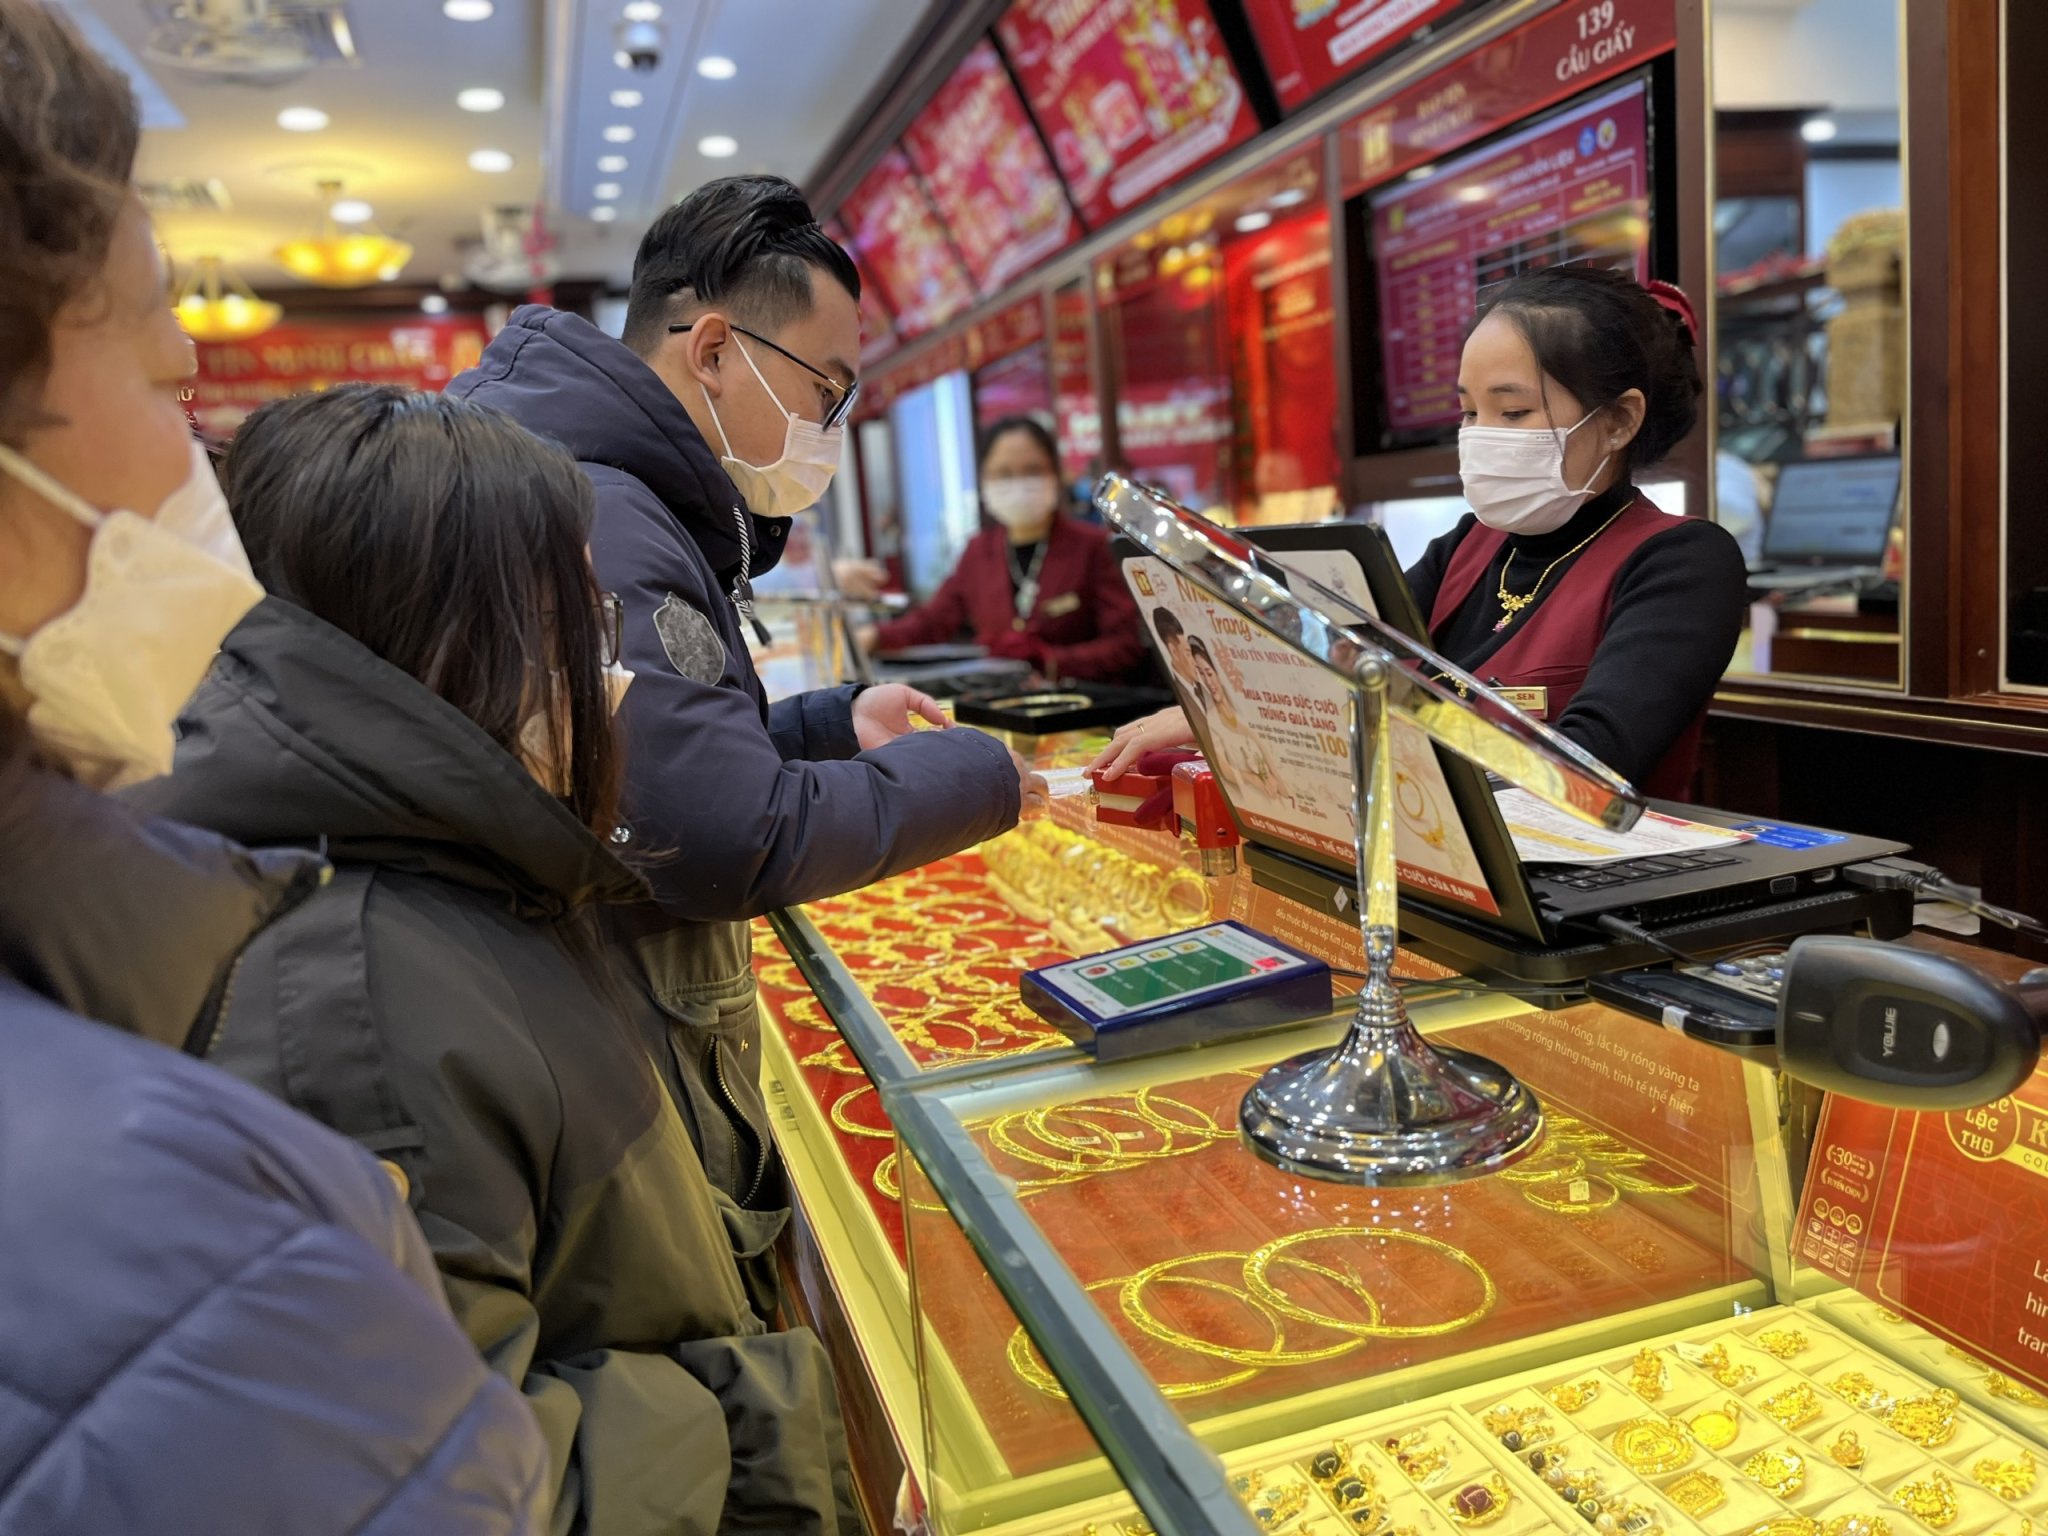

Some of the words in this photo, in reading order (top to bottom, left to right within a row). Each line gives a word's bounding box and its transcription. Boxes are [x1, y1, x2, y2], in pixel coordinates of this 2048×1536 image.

[1577, 0, 1614, 40] 139
[1555, 43, 1591, 81] CẦU
[1592, 19, 1636, 64] GIẤY
[1206, 608, 1253, 641] Trang
[1241, 687, 1262, 702] MUA
[1262, 691, 1292, 706] TRANG
[1293, 694, 1312, 709] SỨC
[1258, 705, 1287, 722] TRÚNG
[1288, 710, 1309, 727] QUÀ
[1317, 733, 1348, 758] 100
[1428, 875, 1451, 893] CỦA
[1329, 933, 1341, 945] Kim
[1532, 1031, 1553, 1052] rồng
[1555, 1040, 1579, 1064] hùng
[1581, 1055, 1610, 1079] mạnh,
[1882, 1007, 1897, 1057] YOUJIE
[1549, 1013, 1569, 1031] hình
[1570, 1024, 1594, 1046] rồng,
[1613, 1043, 1629, 1061] tay
[1630, 1052, 1656, 1075] rồng
[1658, 1064, 1686, 1088] vàng
[1688, 1076, 1700, 1092] ta
[1965, 1109, 1999, 1132] LỘC
[1961, 1130, 1994, 1157] THỌ
